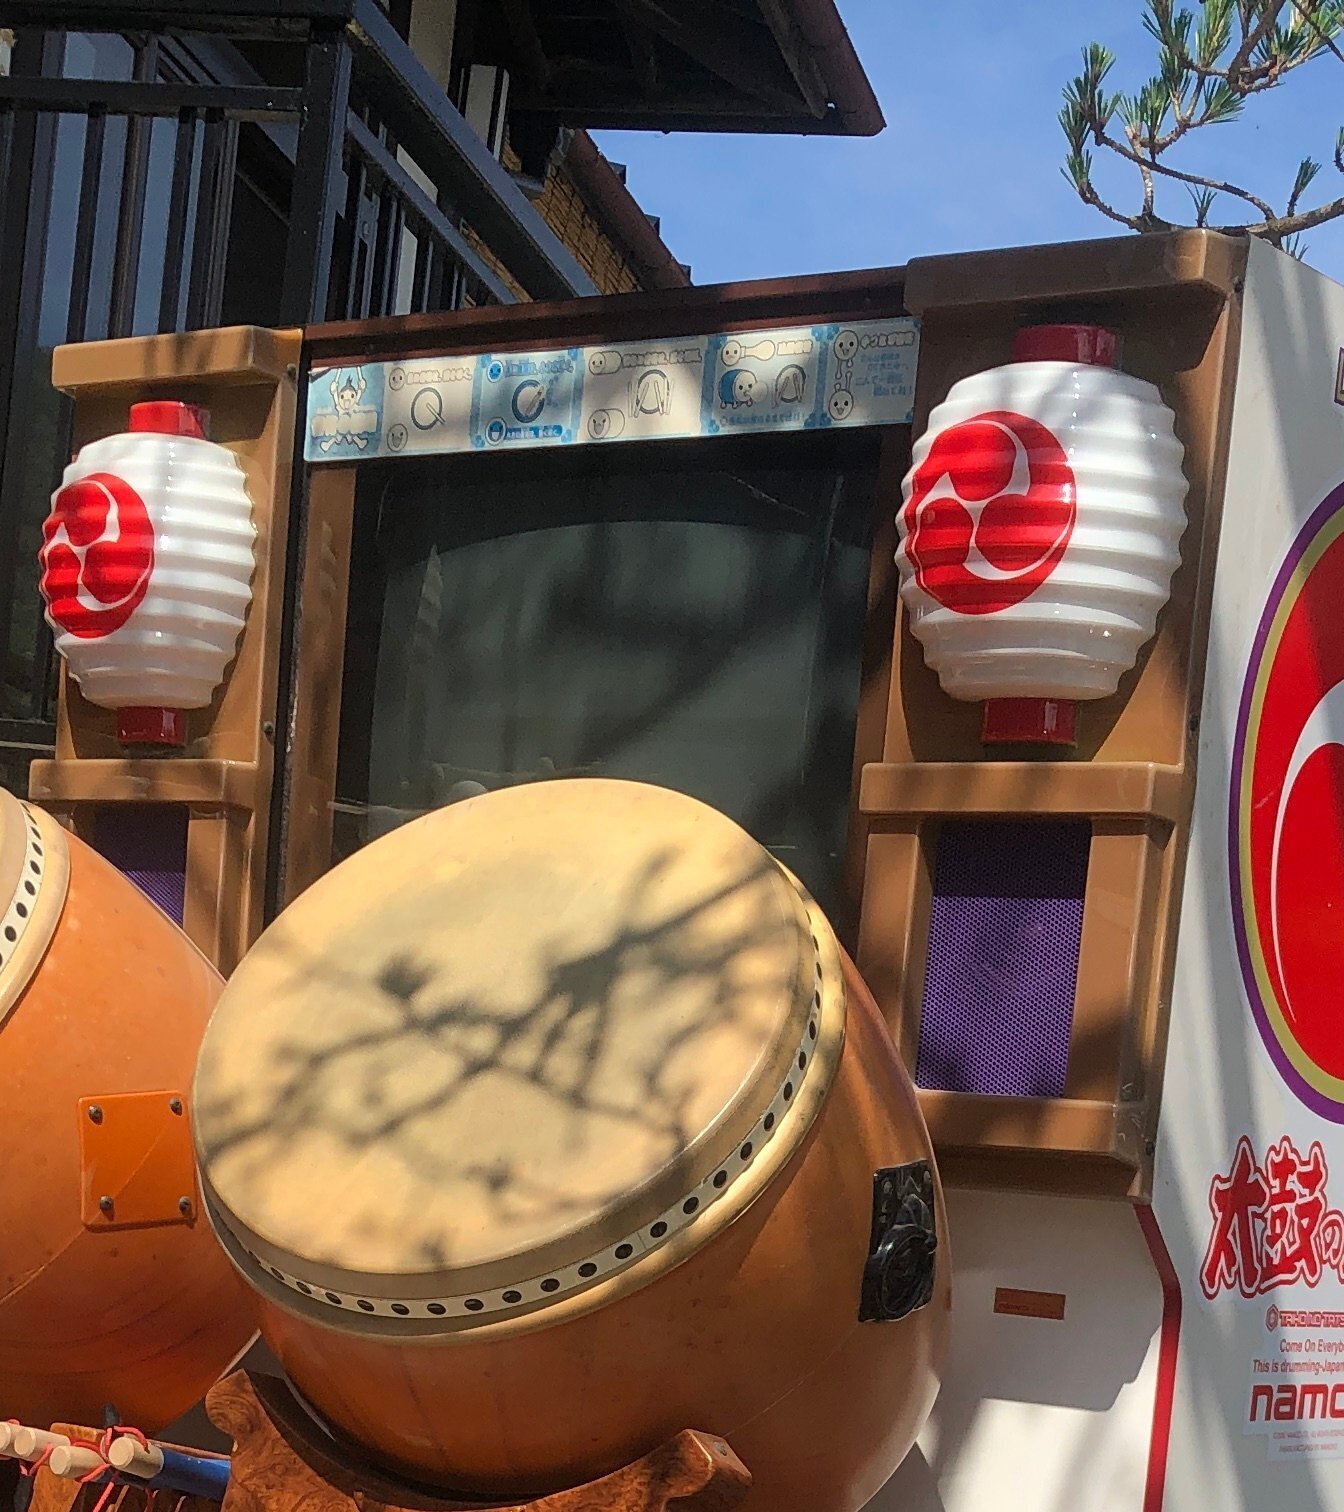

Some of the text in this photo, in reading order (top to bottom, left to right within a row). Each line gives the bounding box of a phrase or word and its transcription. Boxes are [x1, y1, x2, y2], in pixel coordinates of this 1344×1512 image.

[1279, 1338, 1303, 1353] Come
[1304, 1338, 1316, 1353] On
[1253, 1358, 1270, 1373] This
[1271, 1359, 1279, 1373] is
